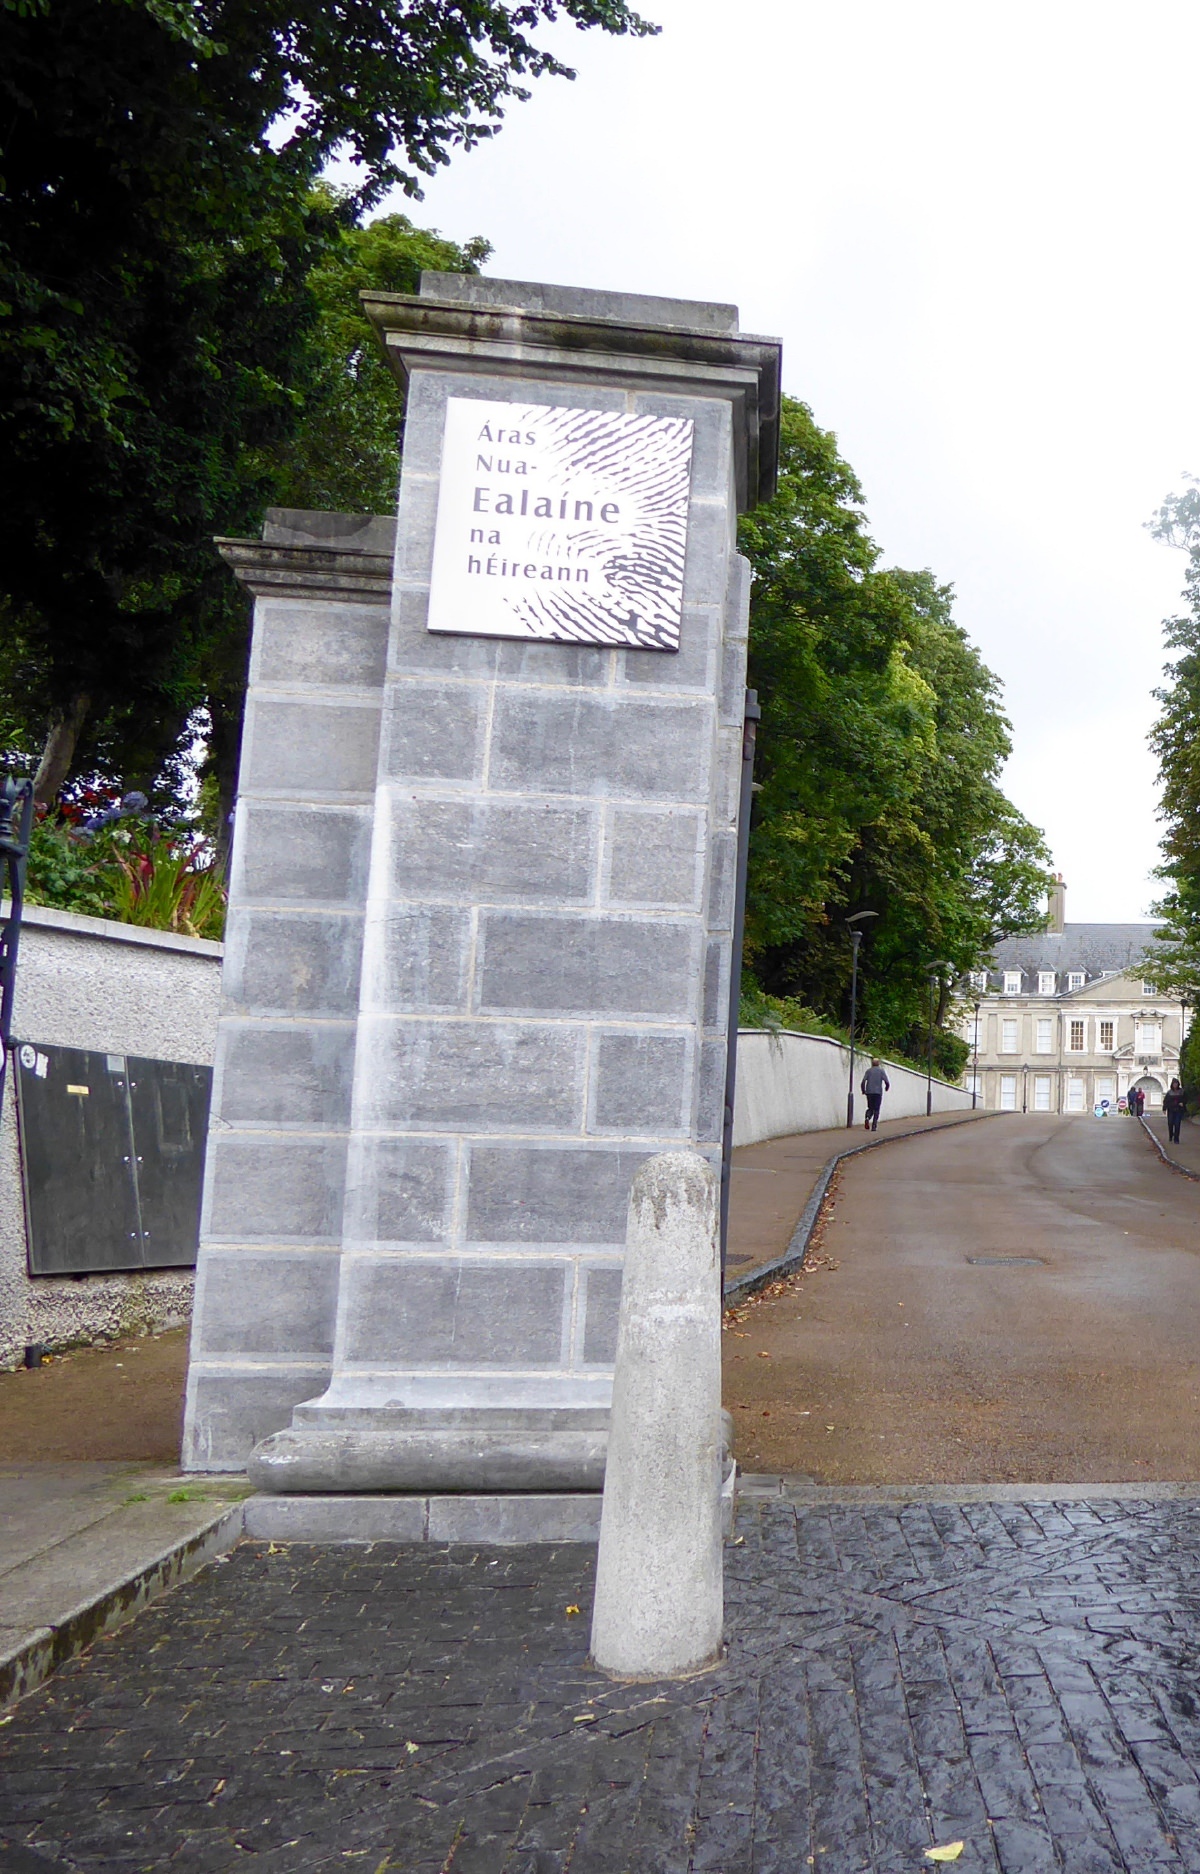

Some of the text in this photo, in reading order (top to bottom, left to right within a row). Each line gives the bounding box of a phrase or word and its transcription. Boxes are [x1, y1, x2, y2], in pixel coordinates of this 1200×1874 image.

[477, 420, 536, 446] Áras
[476, 454, 537, 476] Nua-
[472, 486, 621, 524] Ealaíne
[470, 528, 501, 545] na
[467, 552, 589, 583] hÉireann
